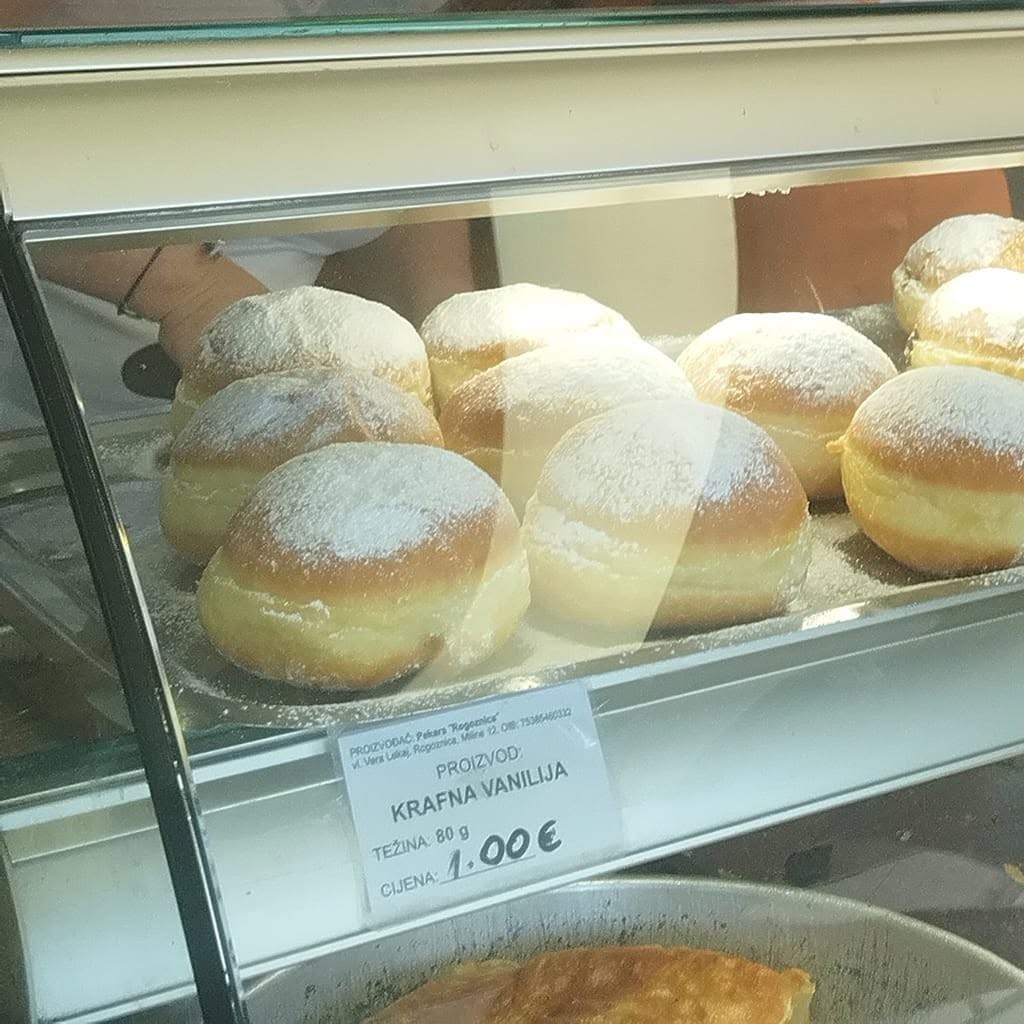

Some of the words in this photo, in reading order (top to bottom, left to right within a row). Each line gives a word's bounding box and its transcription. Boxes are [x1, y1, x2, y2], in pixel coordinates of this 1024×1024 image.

[436, 744, 523, 779] PROIZVOD:
[391, 784, 478, 824] KRAFNA
[481, 760, 569, 798] VANILIJA
[372, 833, 431, 862] TEŽINA:
[435, 827, 455, 843] 80
[458, 825, 470, 841] g
[380, 871, 439, 898] CIJENA:
